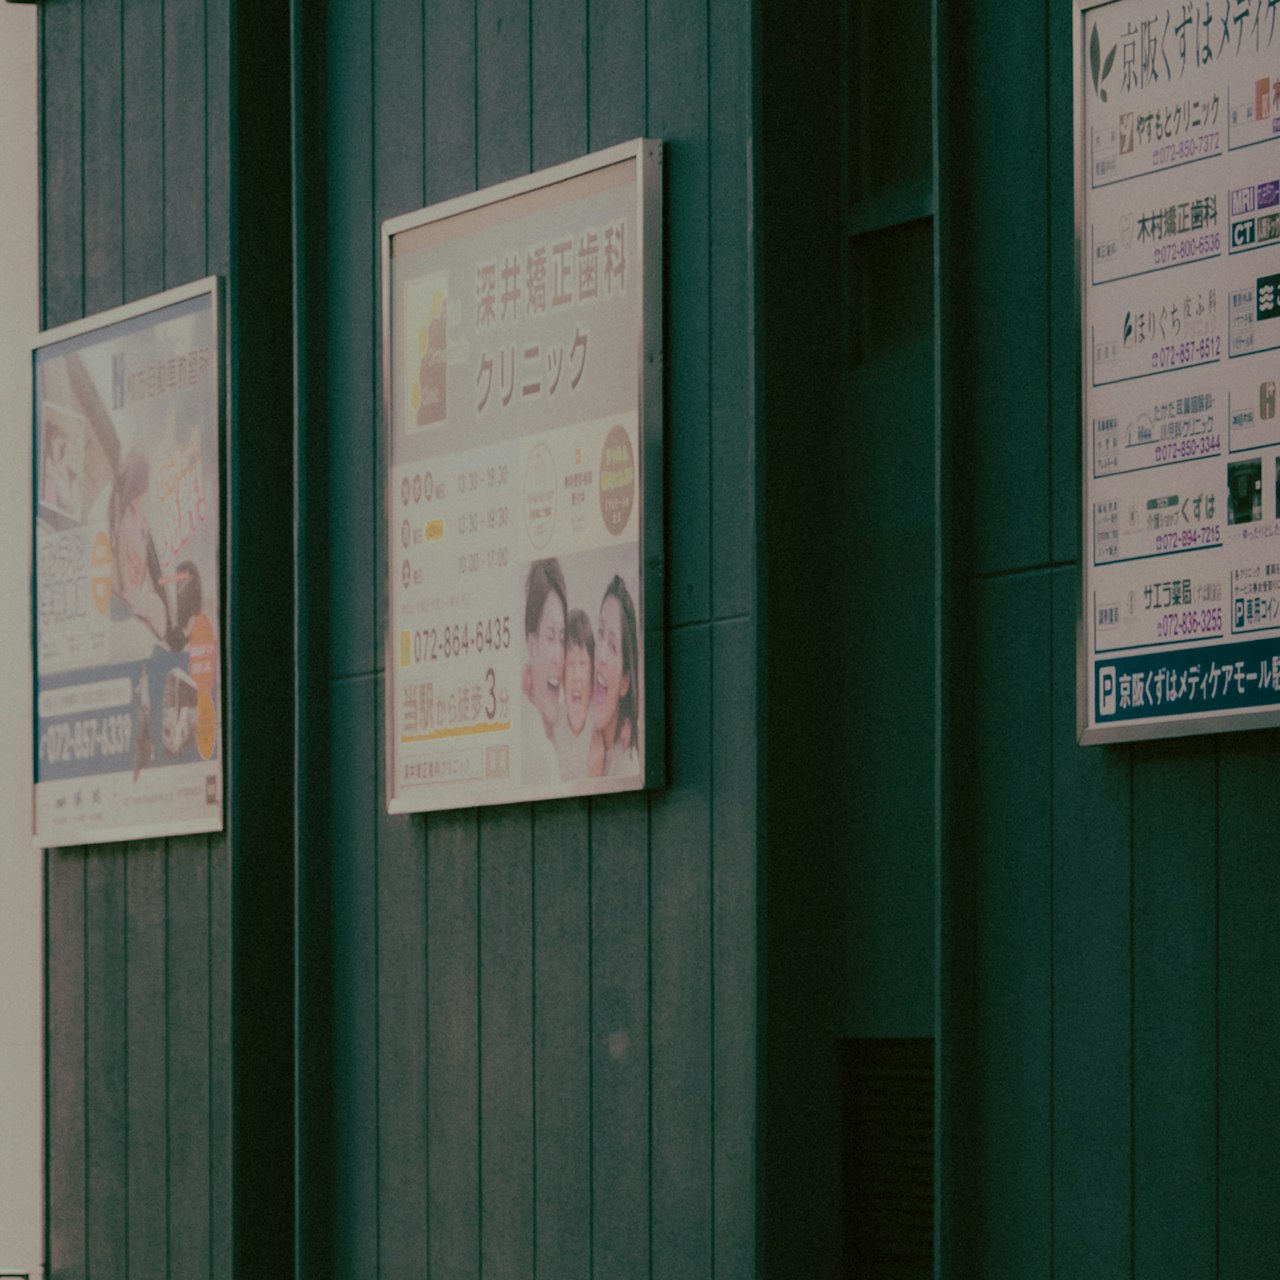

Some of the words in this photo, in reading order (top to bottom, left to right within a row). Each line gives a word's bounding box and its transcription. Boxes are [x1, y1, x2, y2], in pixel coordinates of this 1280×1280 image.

[1136, 94, 1219, 145] やすもとクリニック
[1159, 132, 1220, 165] 072-850-7372
[1232, 187, 1254, 214] MRI
[1137, 195, 1217, 243] 木村矯正歯科
[1233, 221, 1253, 246] CT
[1160, 233, 1220, 265] 072-800-6536
[475, 222, 627, 328] 深井矯正歯科
[1134, 304, 1181, 345] ほりぐち
[1160, 336, 1221, 367] 072-857-6512
[476, 327, 589, 413] クリニック
[1161, 434, 1221, 461] 072-850-3344
[1182, 493, 1215, 523] くずは
[1162, 525, 1221, 550] 072-894-7215
[1144, 579, 1192, 610] サエラ薬局
[1162, 608, 1223, 637] 072-836-3255
[413, 615, 511, 663] 072-864-6435
